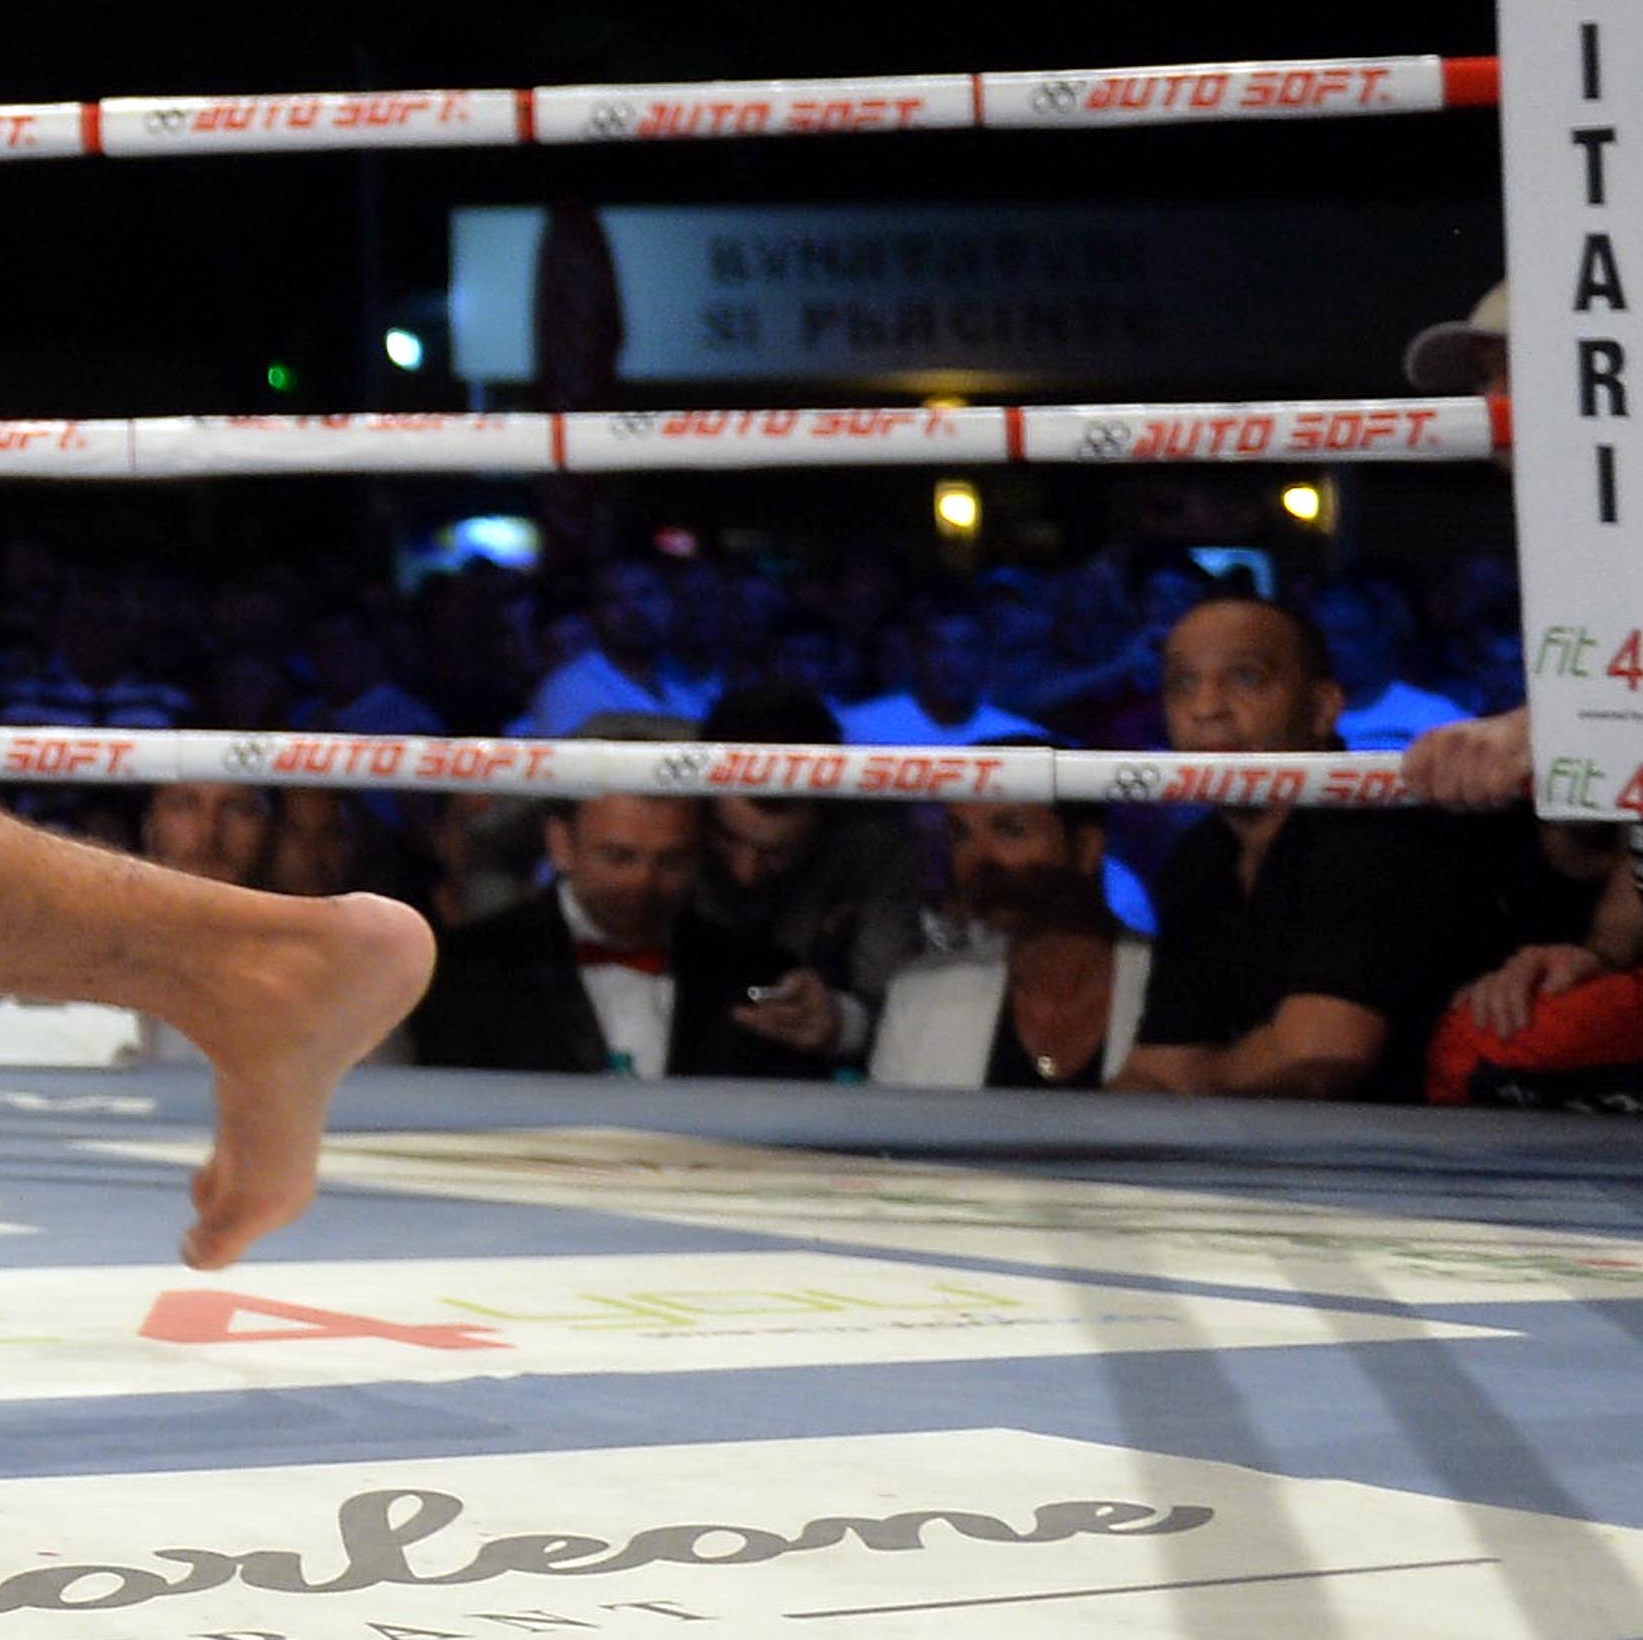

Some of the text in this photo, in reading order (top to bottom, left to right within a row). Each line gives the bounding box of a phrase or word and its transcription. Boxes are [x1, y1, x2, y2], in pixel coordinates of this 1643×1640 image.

[1085, 73, 1229, 110] AUTO
[1132, 417, 1275, 457] AUTO
[708, 752, 847, 789] AUTO
[137, 1287, 512, 1350] 4
